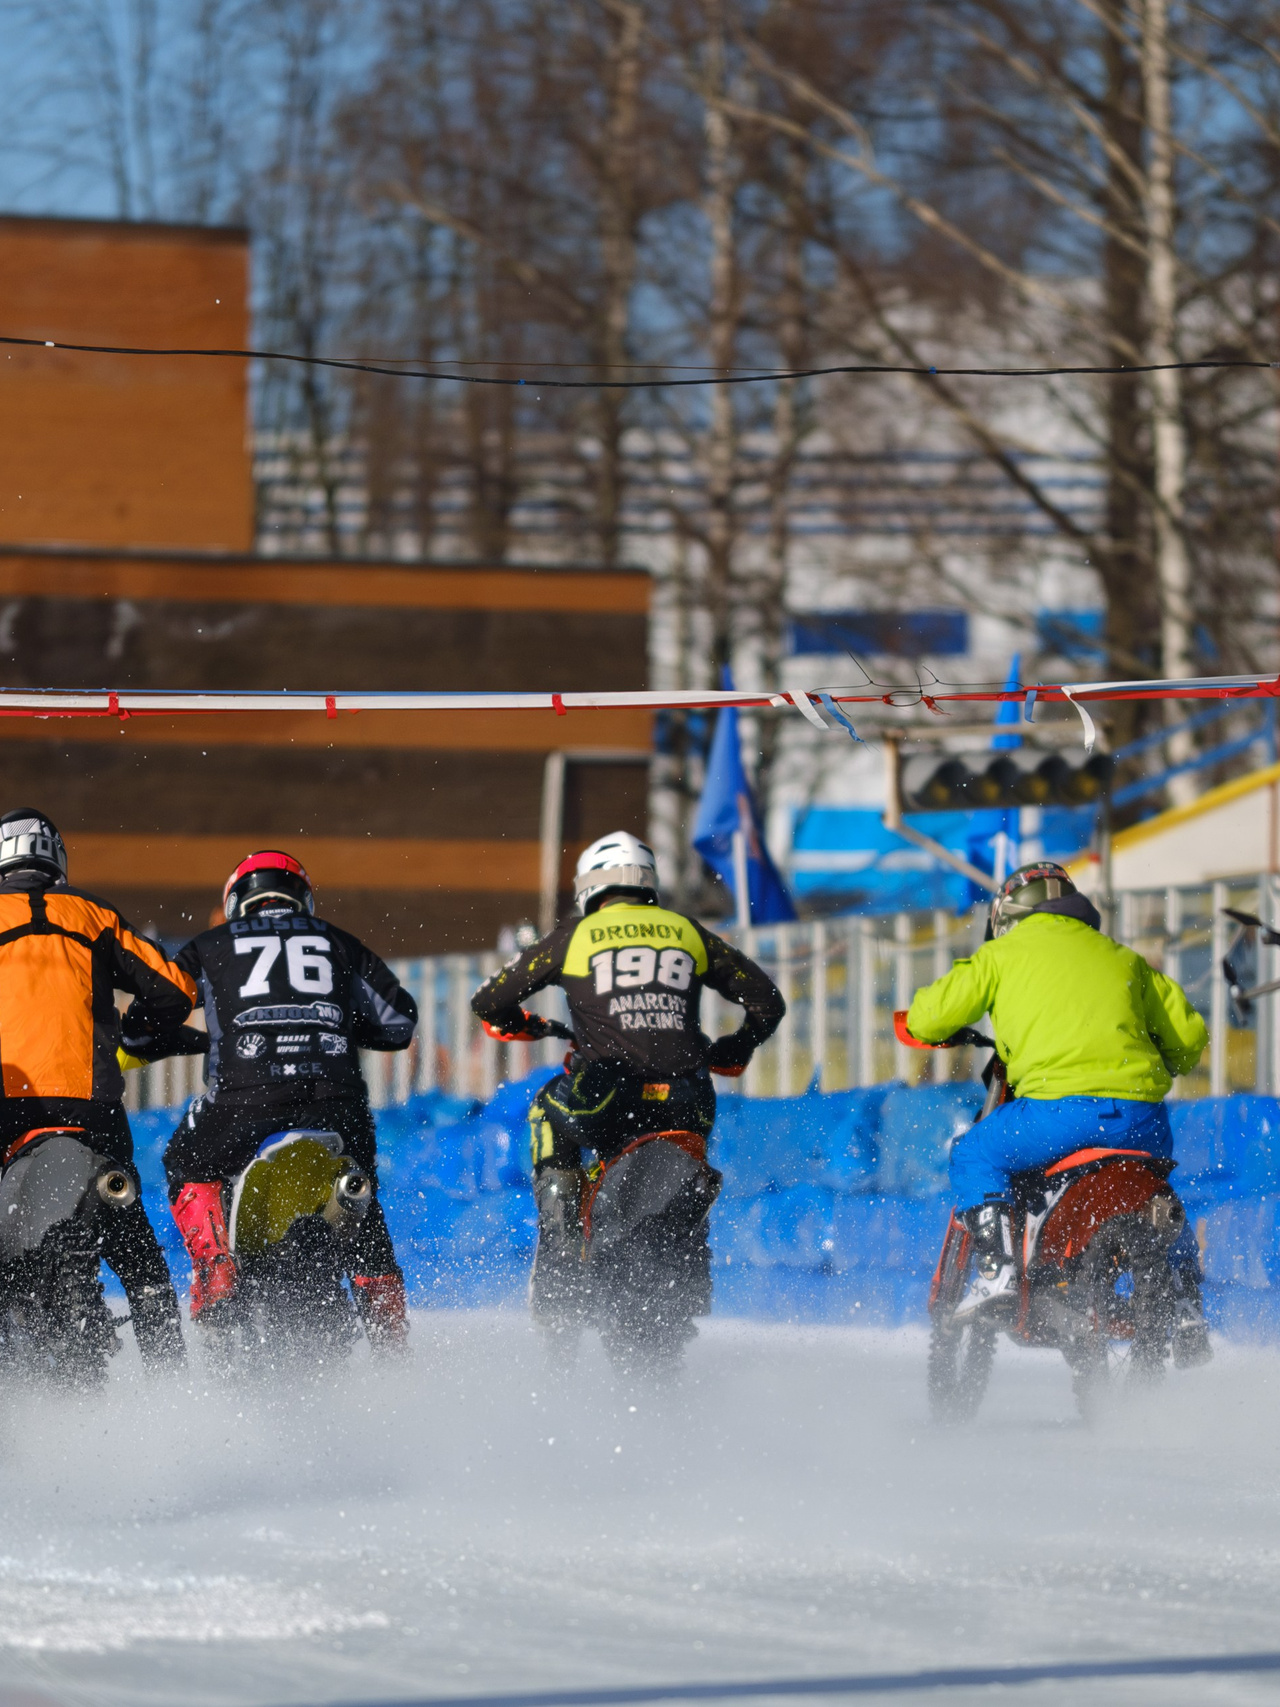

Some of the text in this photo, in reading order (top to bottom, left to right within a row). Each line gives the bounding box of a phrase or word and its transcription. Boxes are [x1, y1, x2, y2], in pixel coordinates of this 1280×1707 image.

[230, 918, 327, 934] GUSEV
[234, 936, 333, 998] 76
[591, 946, 696, 995] 198
[609, 993, 687, 1015] ANARCHY
[620, 1011, 684, 1030] RACING
